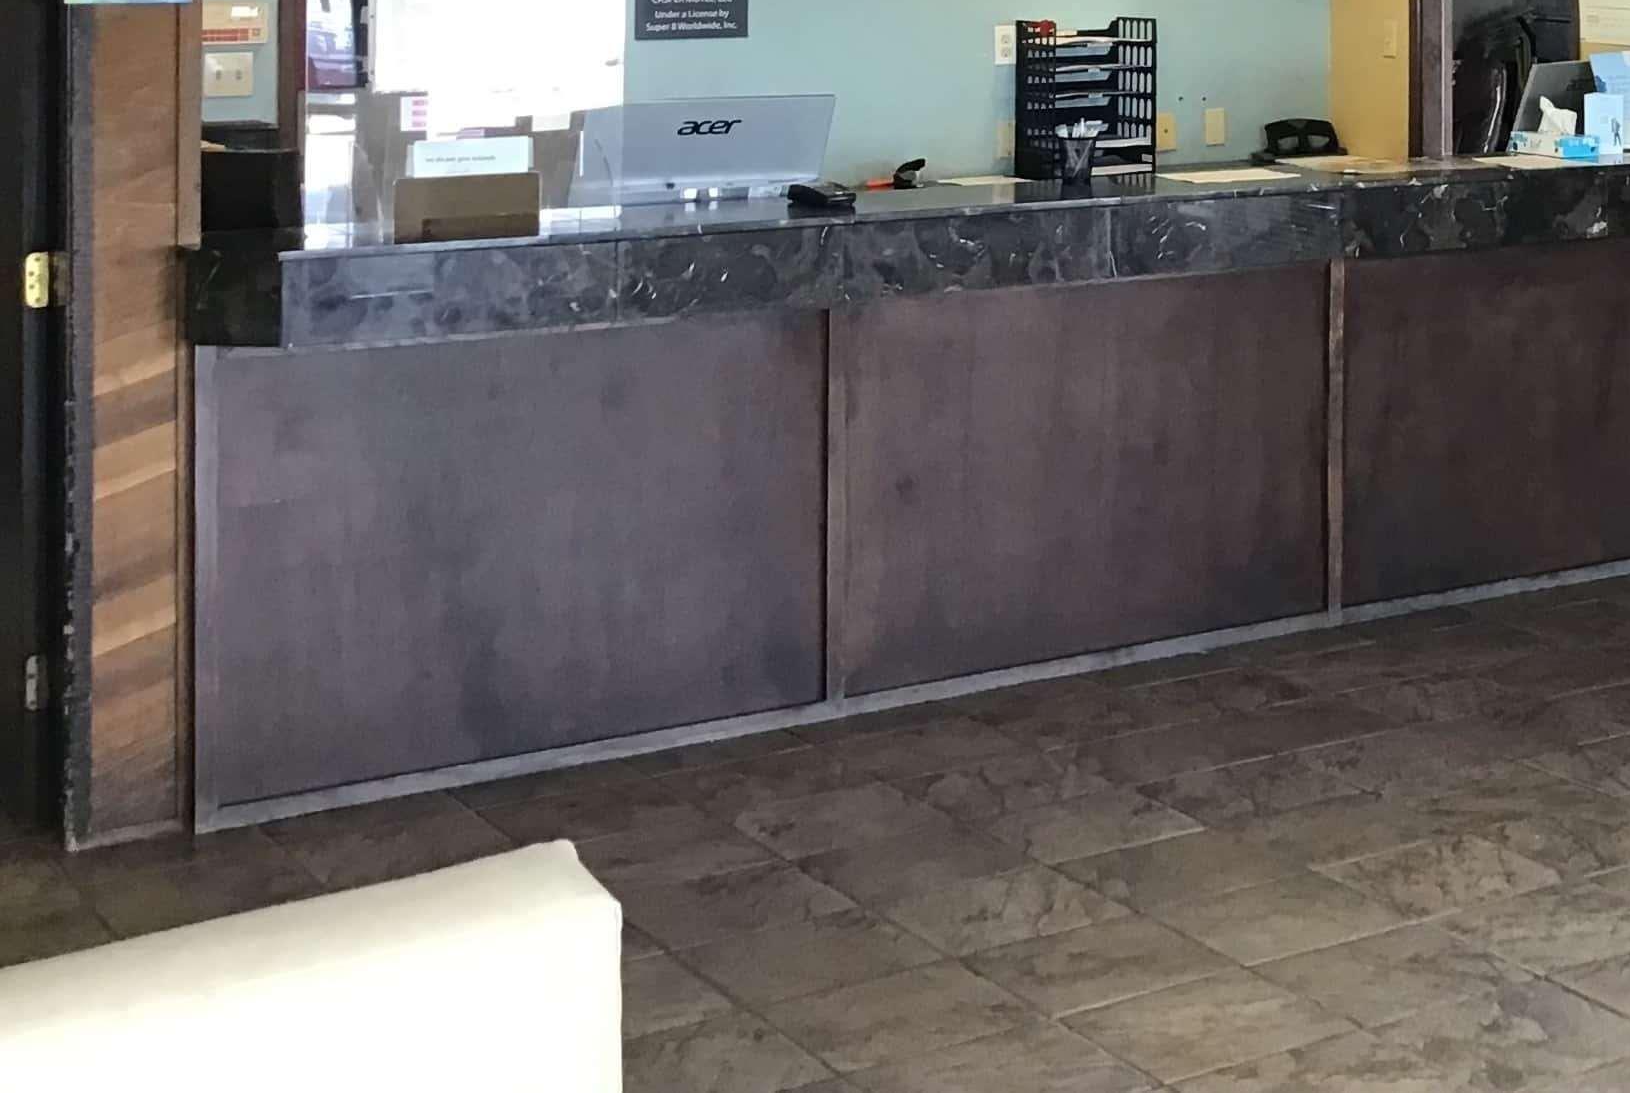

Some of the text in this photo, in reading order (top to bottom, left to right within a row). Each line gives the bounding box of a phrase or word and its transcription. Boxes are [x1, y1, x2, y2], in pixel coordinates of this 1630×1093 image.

[655, 10, 680, 19] Under
[688, 10, 717, 18] License
[719, 9, 730, 19] by
[646, 22, 669, 32] Super
[677, 119, 743, 136] acer
